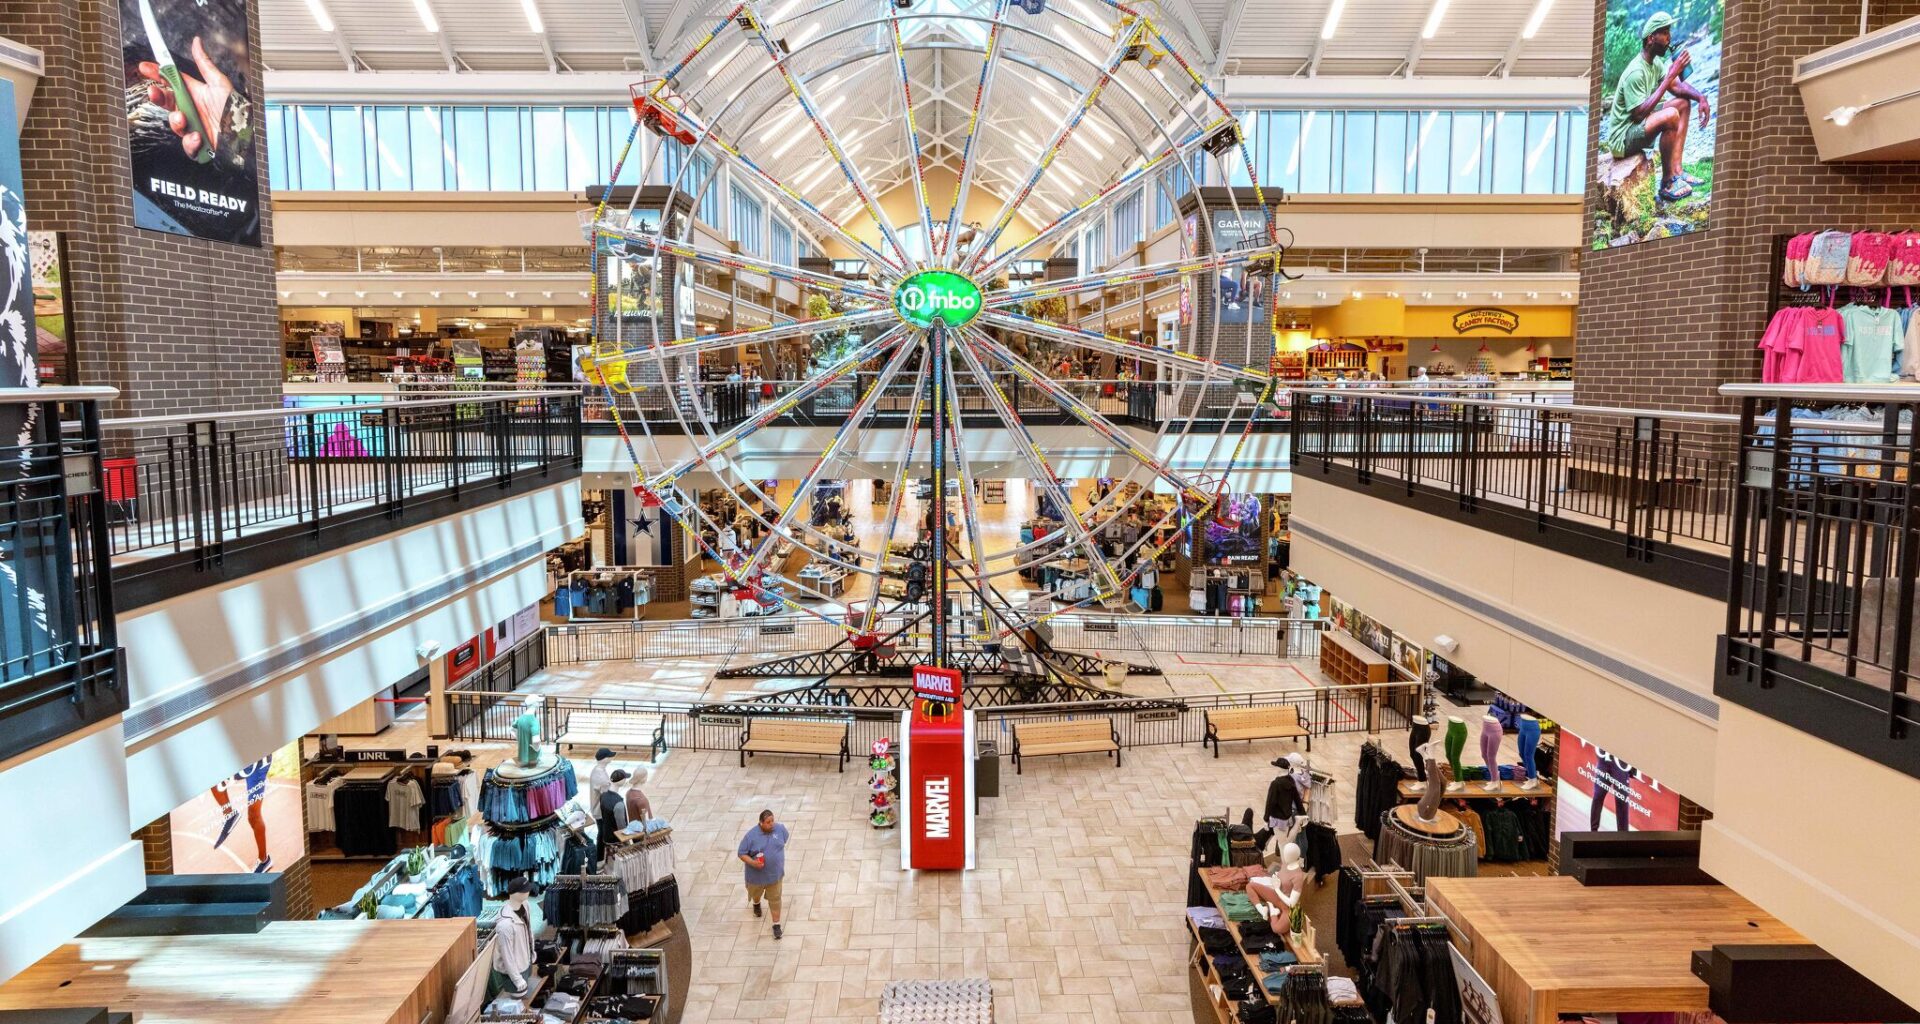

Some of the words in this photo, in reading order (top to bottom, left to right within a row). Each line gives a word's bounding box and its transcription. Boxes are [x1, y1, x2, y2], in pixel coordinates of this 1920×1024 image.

[151, 177, 196, 200] FIELD
[199, 189, 246, 212] READY
[174, 200, 185, 208] The
[928, 290, 975, 309] fnbo
[1460, 318, 1482, 329] CANDY
[1484, 317, 1514, 328] FACTORY
[916, 672, 954, 693] MARVEL
[1137, 711, 1176, 719] SCHEELS
[358, 752, 390, 760] UNRL
[1586, 761, 1592, 769] A
[1592, 765, 1606, 778] New
[1605, 772, 1642, 800] Perspective
[1587, 772, 1625, 801] Performance
[925, 776, 949, 837] MARVEL
